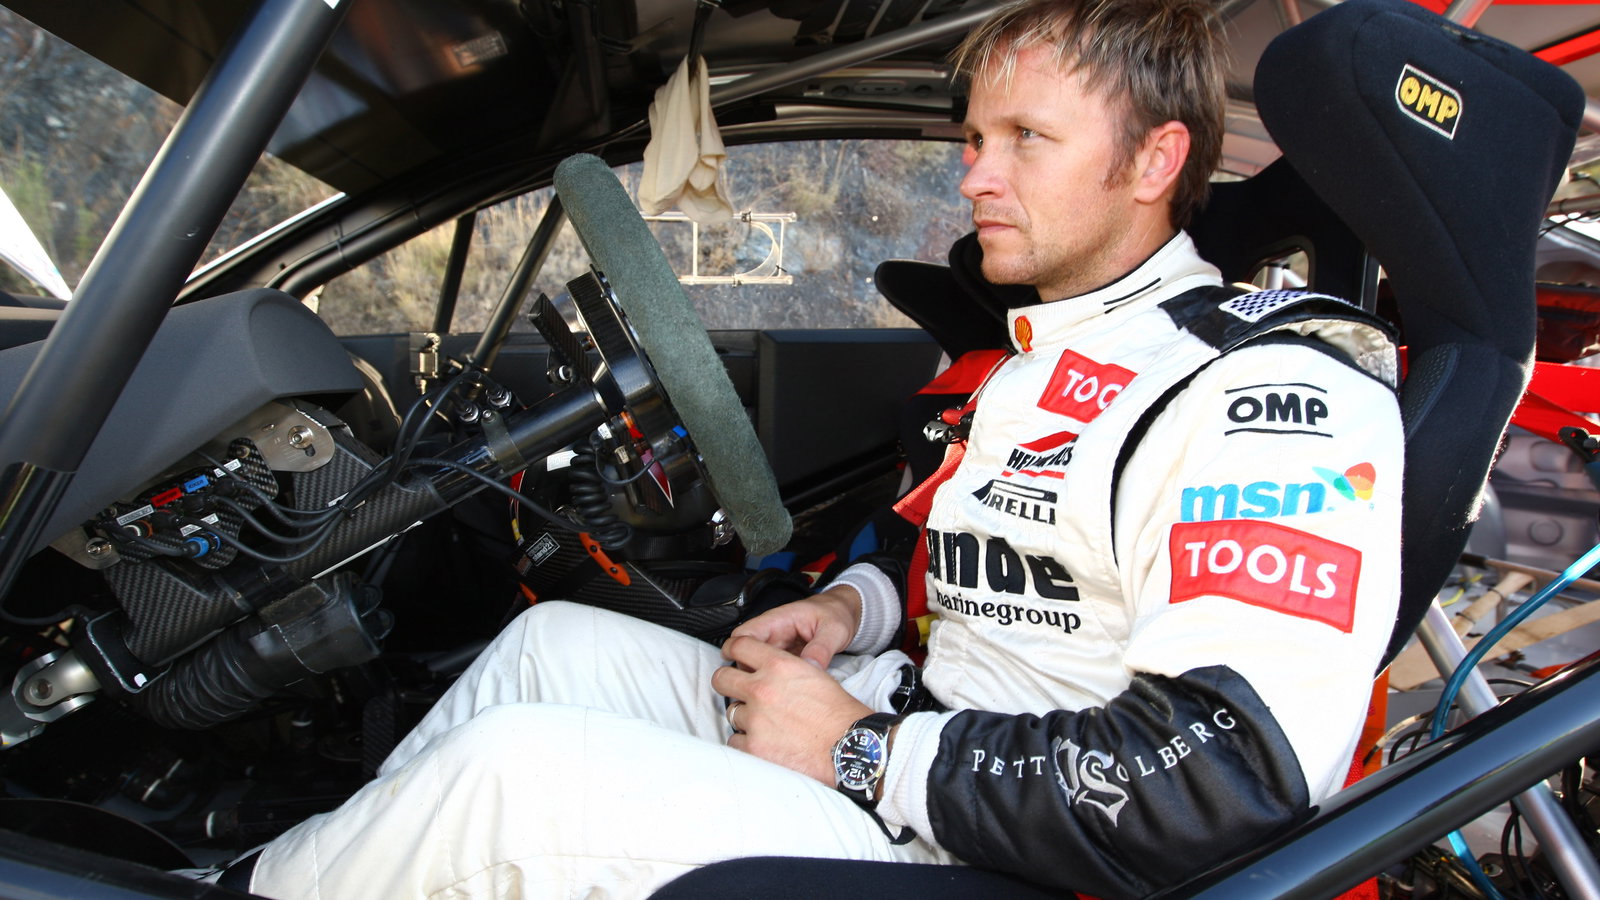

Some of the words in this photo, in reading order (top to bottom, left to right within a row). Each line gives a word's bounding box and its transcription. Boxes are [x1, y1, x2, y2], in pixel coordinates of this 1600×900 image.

[1400, 76, 1458, 123] OMP
[1227, 393, 1328, 425] OMP
[1180, 481, 1326, 522] msn
[1185, 540, 1338, 598] TOOLS
